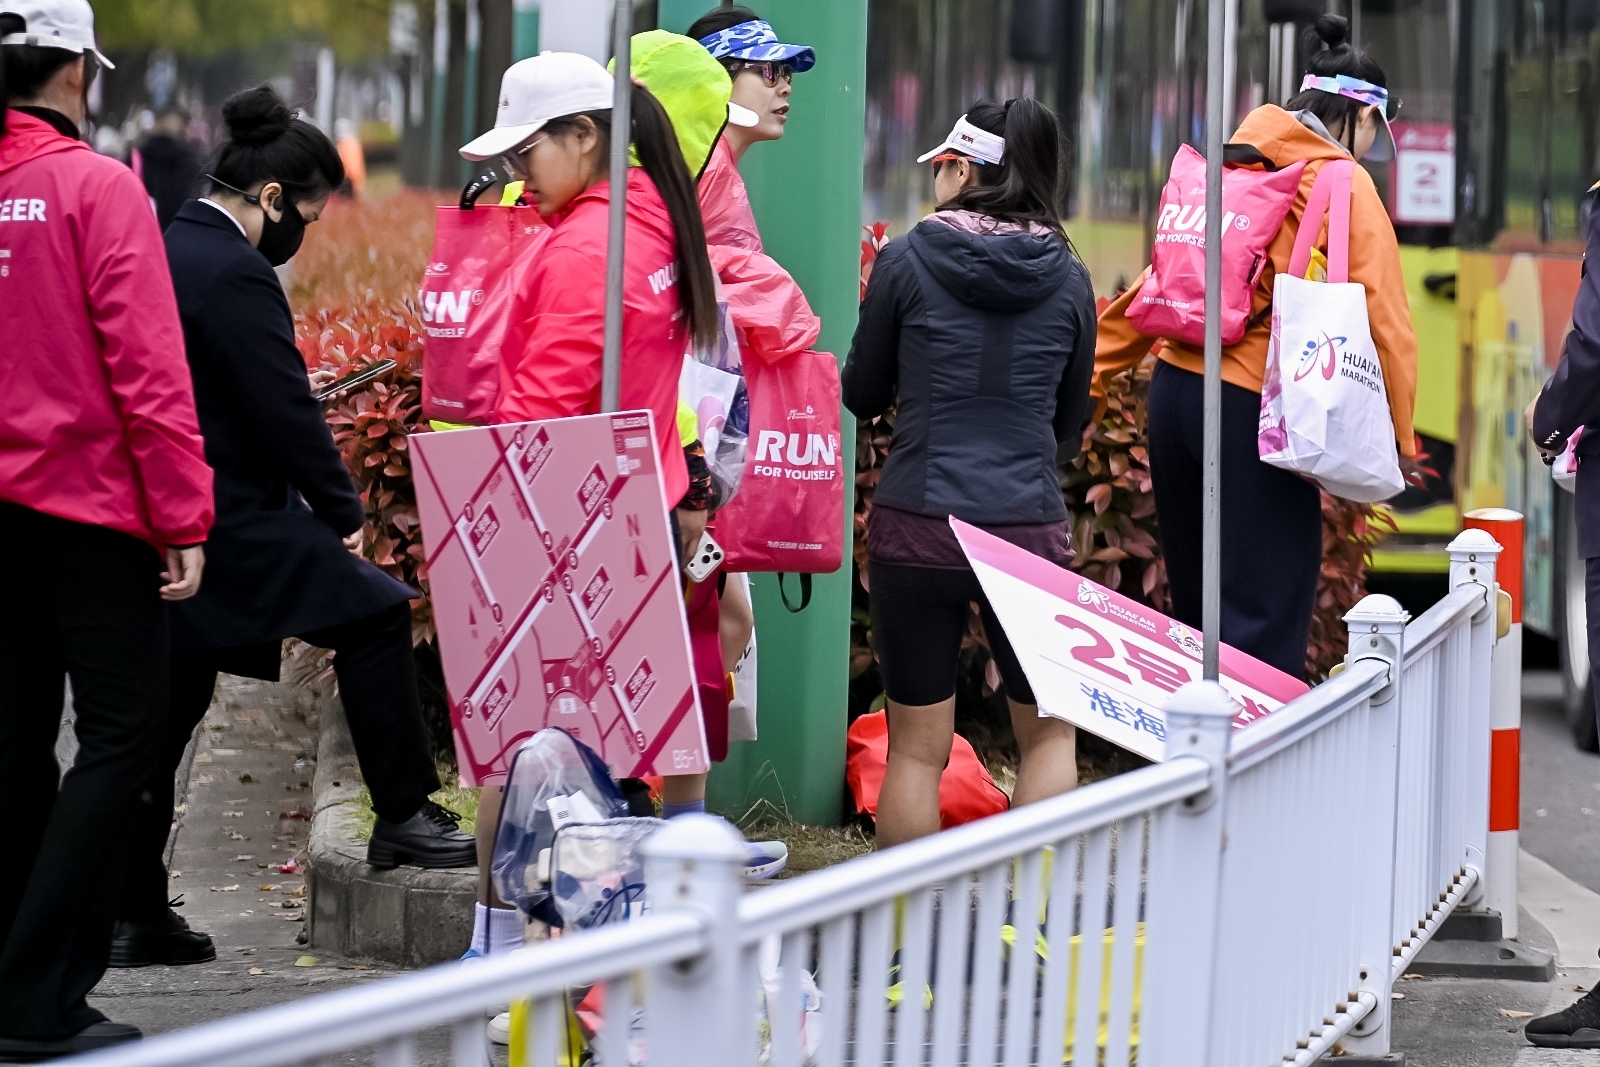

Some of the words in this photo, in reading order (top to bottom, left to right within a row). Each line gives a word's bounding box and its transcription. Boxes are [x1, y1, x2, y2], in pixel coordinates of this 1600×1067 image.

[418, 289, 472, 324] UN
[1340, 367, 1380, 394] MARATHON
[754, 429, 836, 466] RUN
[753, 465, 781, 478] FOR
[625, 514, 641, 537] N
